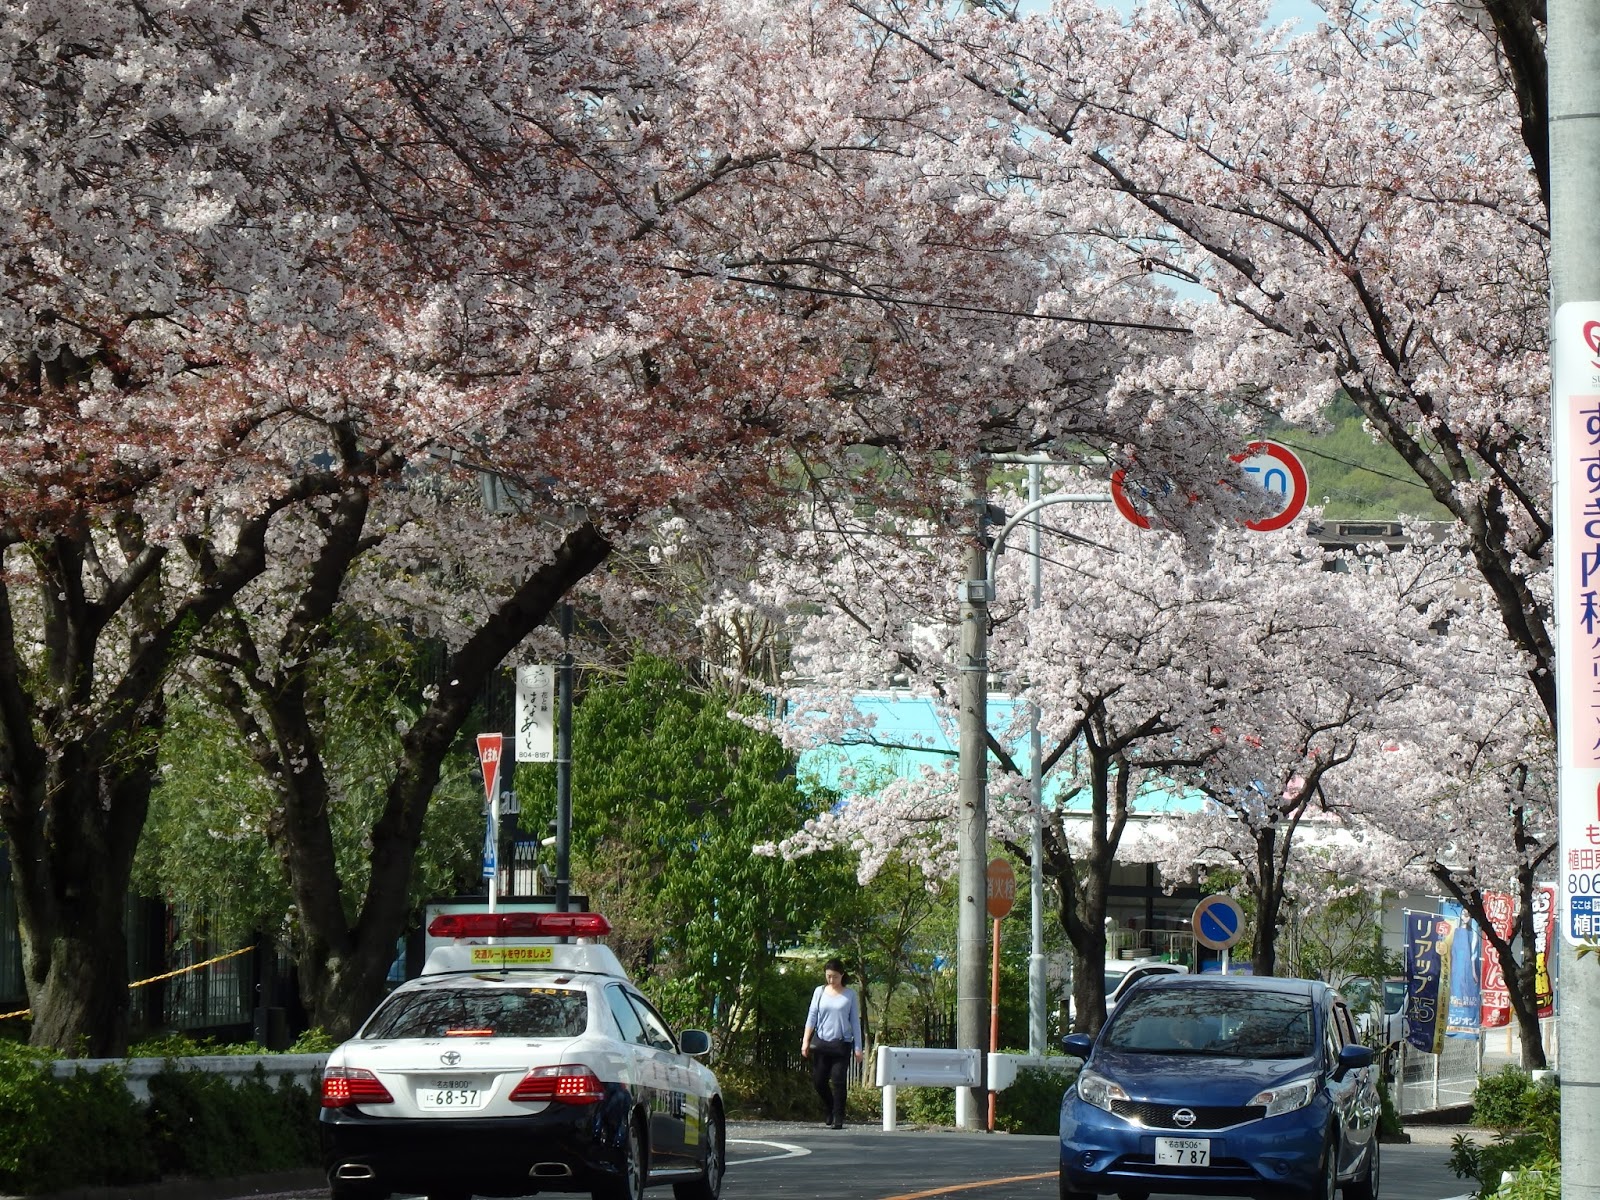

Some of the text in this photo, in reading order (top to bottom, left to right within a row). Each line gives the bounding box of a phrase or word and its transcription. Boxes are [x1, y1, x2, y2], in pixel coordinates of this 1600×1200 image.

[482, 747, 498, 763] 止まれ
[474, 949, 552, 959] 交通ルールを守りましょう
[1413, 918, 1432, 994] リアップ
[1484, 991, 1510, 1007] 受付
[436, 1090, 477, 1105] 68-57
